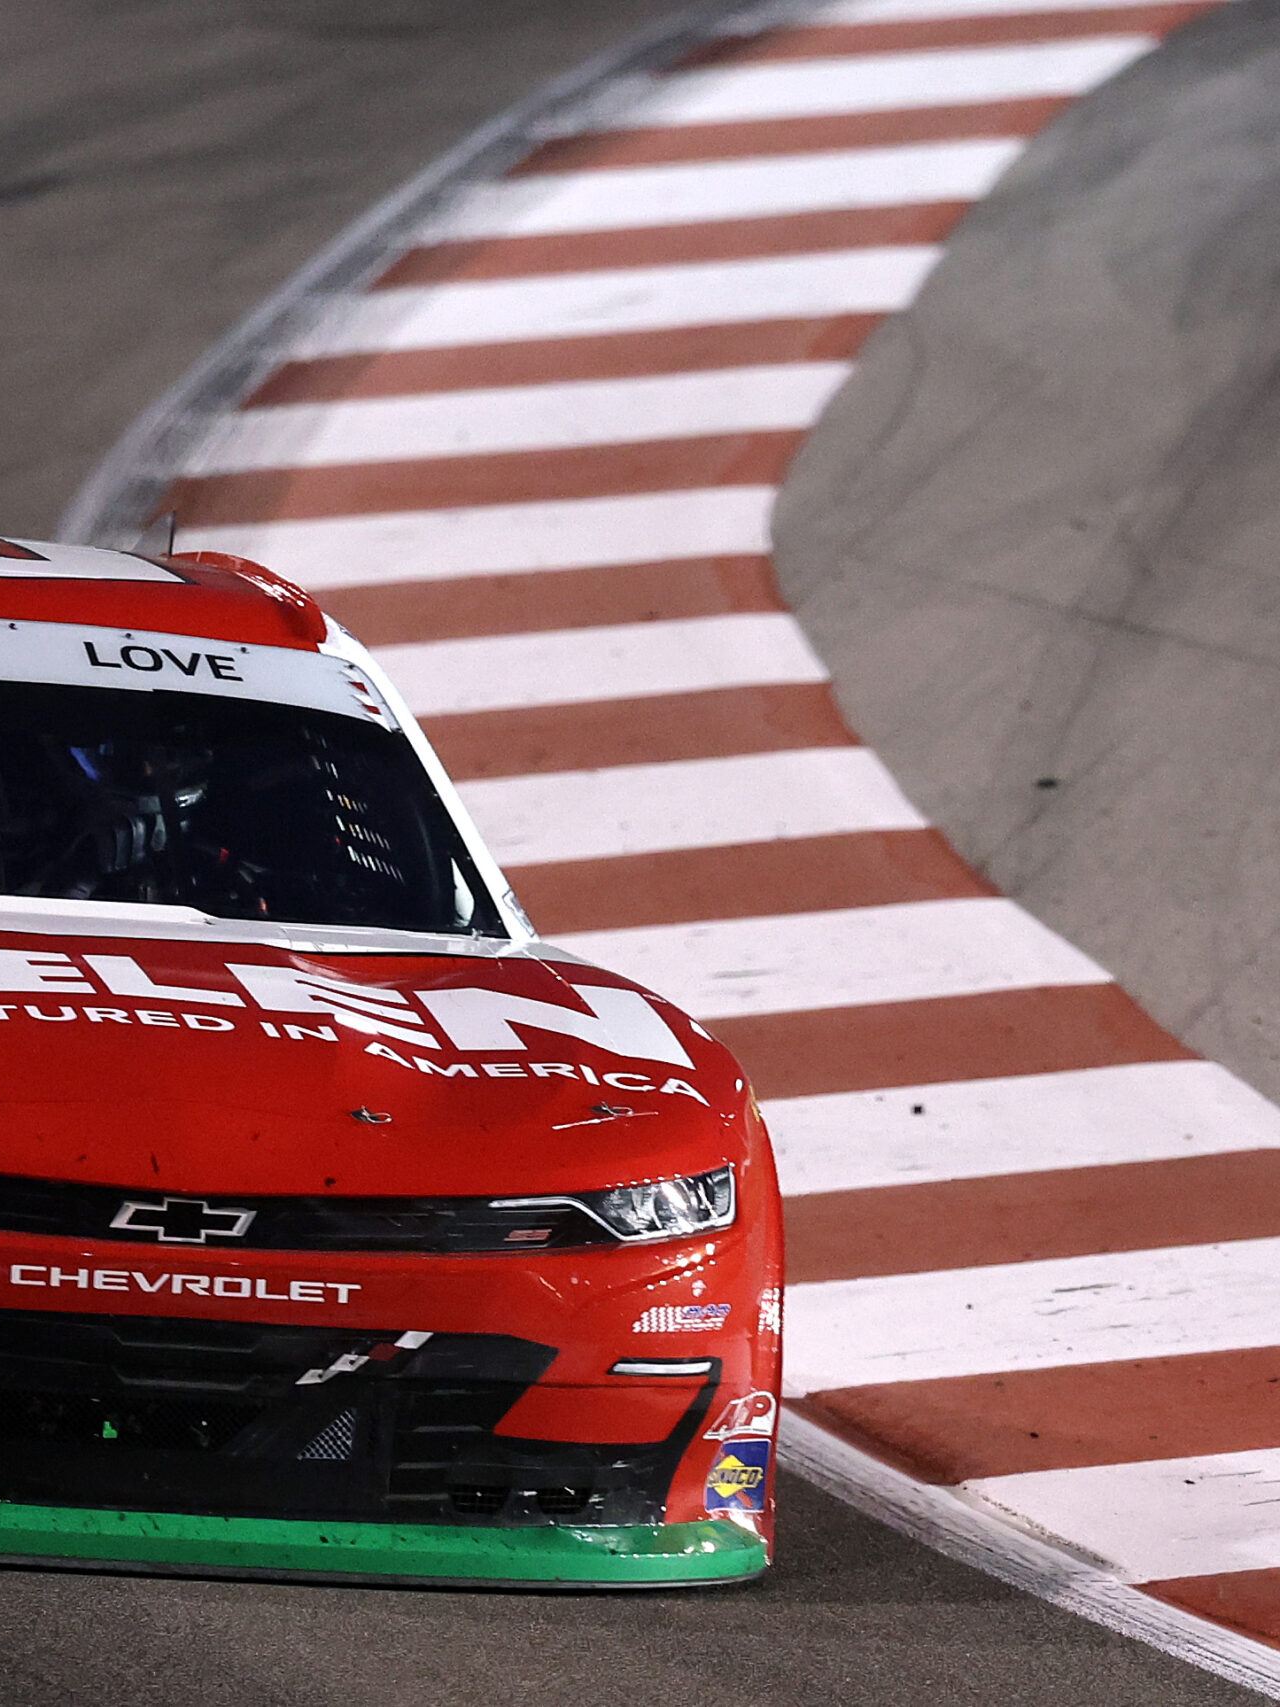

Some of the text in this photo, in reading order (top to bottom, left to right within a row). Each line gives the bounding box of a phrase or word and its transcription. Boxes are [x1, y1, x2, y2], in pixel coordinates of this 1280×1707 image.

[83, 641, 245, 682] LOVE
[261, 1022, 339, 1042] IN
[364, 1041, 710, 1107] AMERICA
[10, 1264, 362, 1304] CHEVROLET
